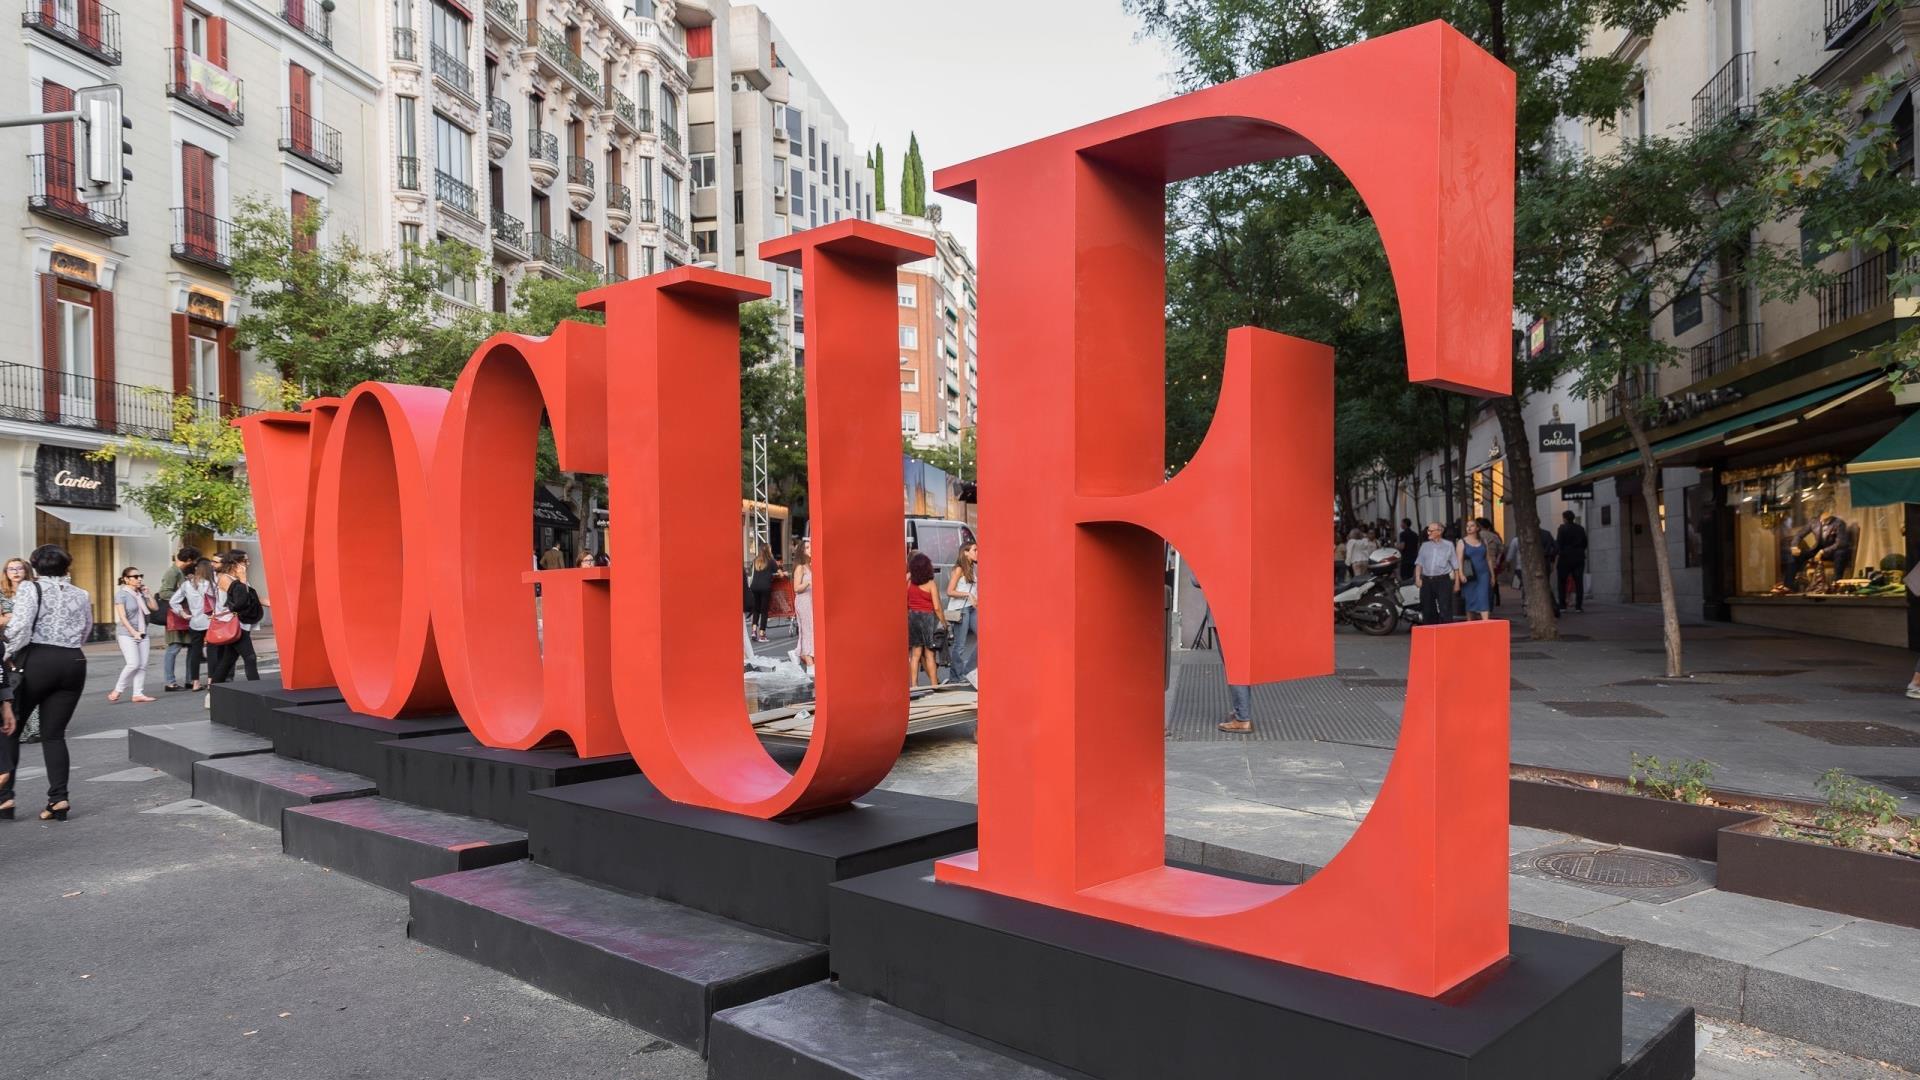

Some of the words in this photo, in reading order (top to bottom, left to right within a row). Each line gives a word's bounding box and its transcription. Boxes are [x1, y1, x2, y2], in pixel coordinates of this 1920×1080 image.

[1542, 438, 1574, 447] OMEGA
[54, 470, 102, 490] Cartier
[231, 19, 1516, 998] VOGUE
